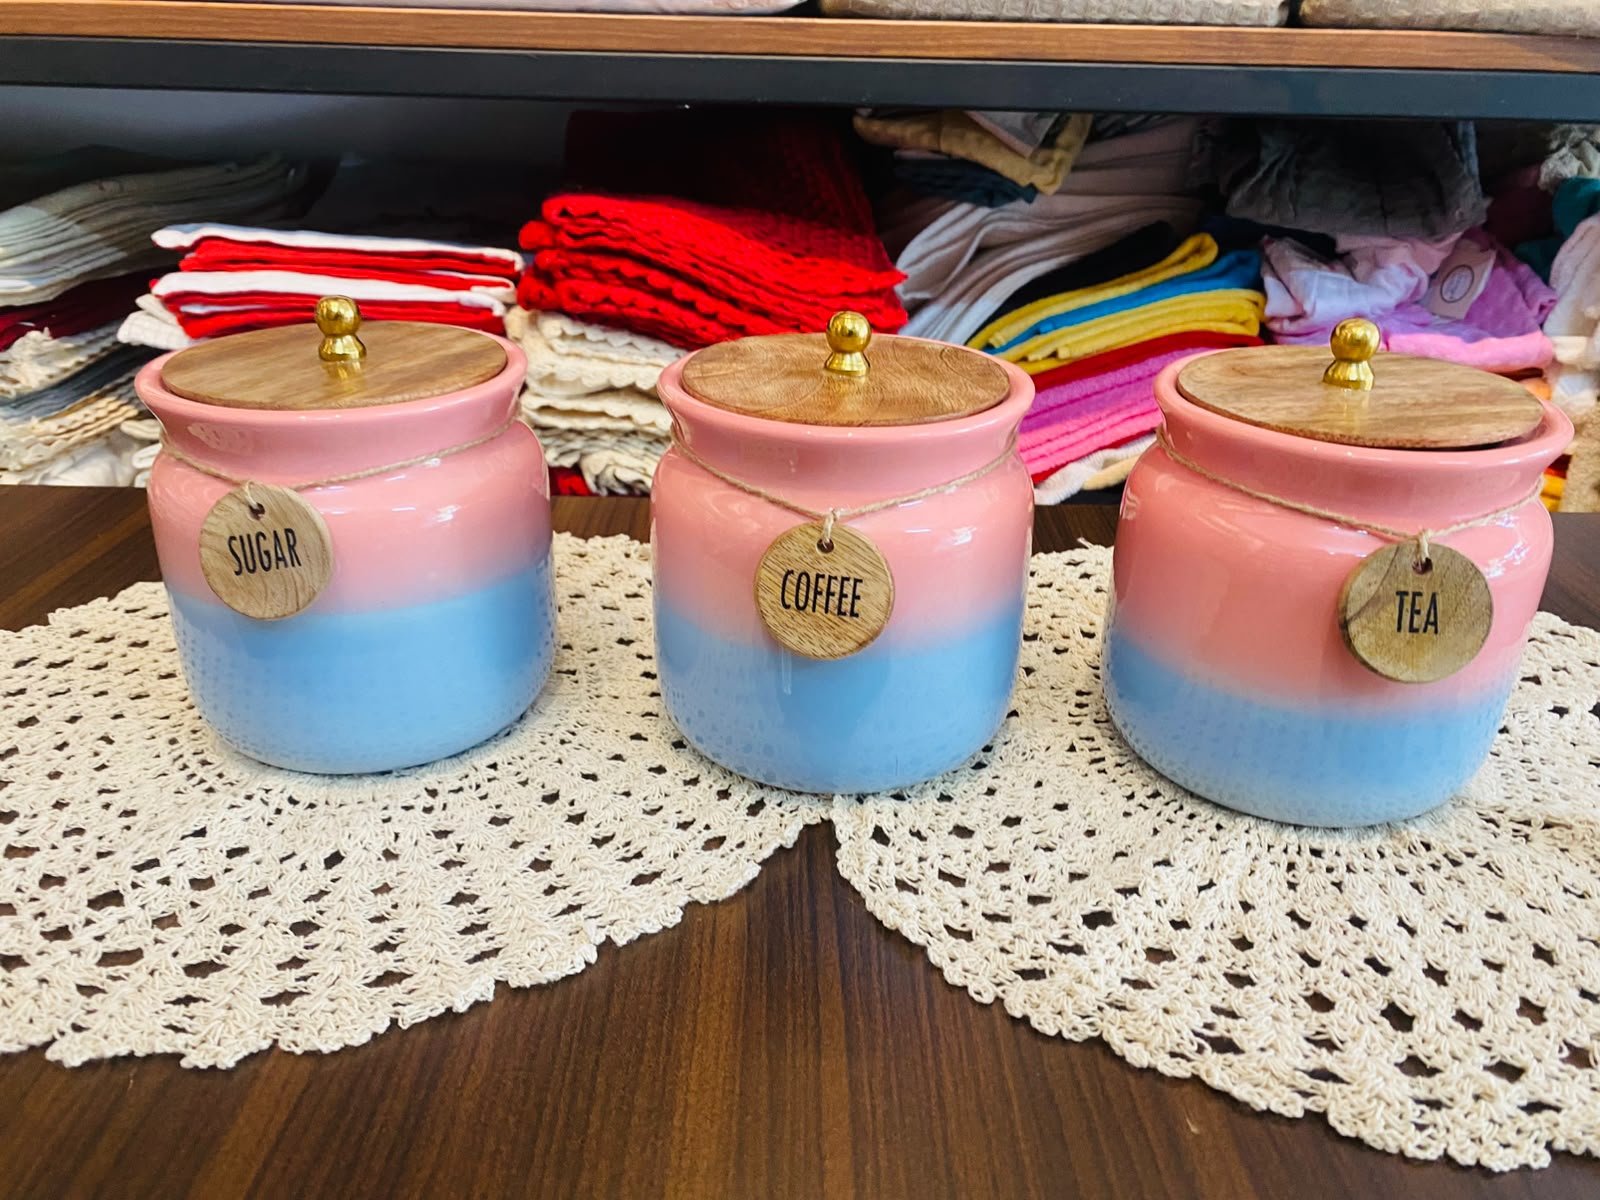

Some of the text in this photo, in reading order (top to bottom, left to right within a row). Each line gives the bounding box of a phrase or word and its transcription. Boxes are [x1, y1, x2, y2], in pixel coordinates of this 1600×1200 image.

[227, 528, 302, 576] SUGAR
[780, 569, 863, 618] COFFEE
[1395, 590, 1439, 635] TEA
